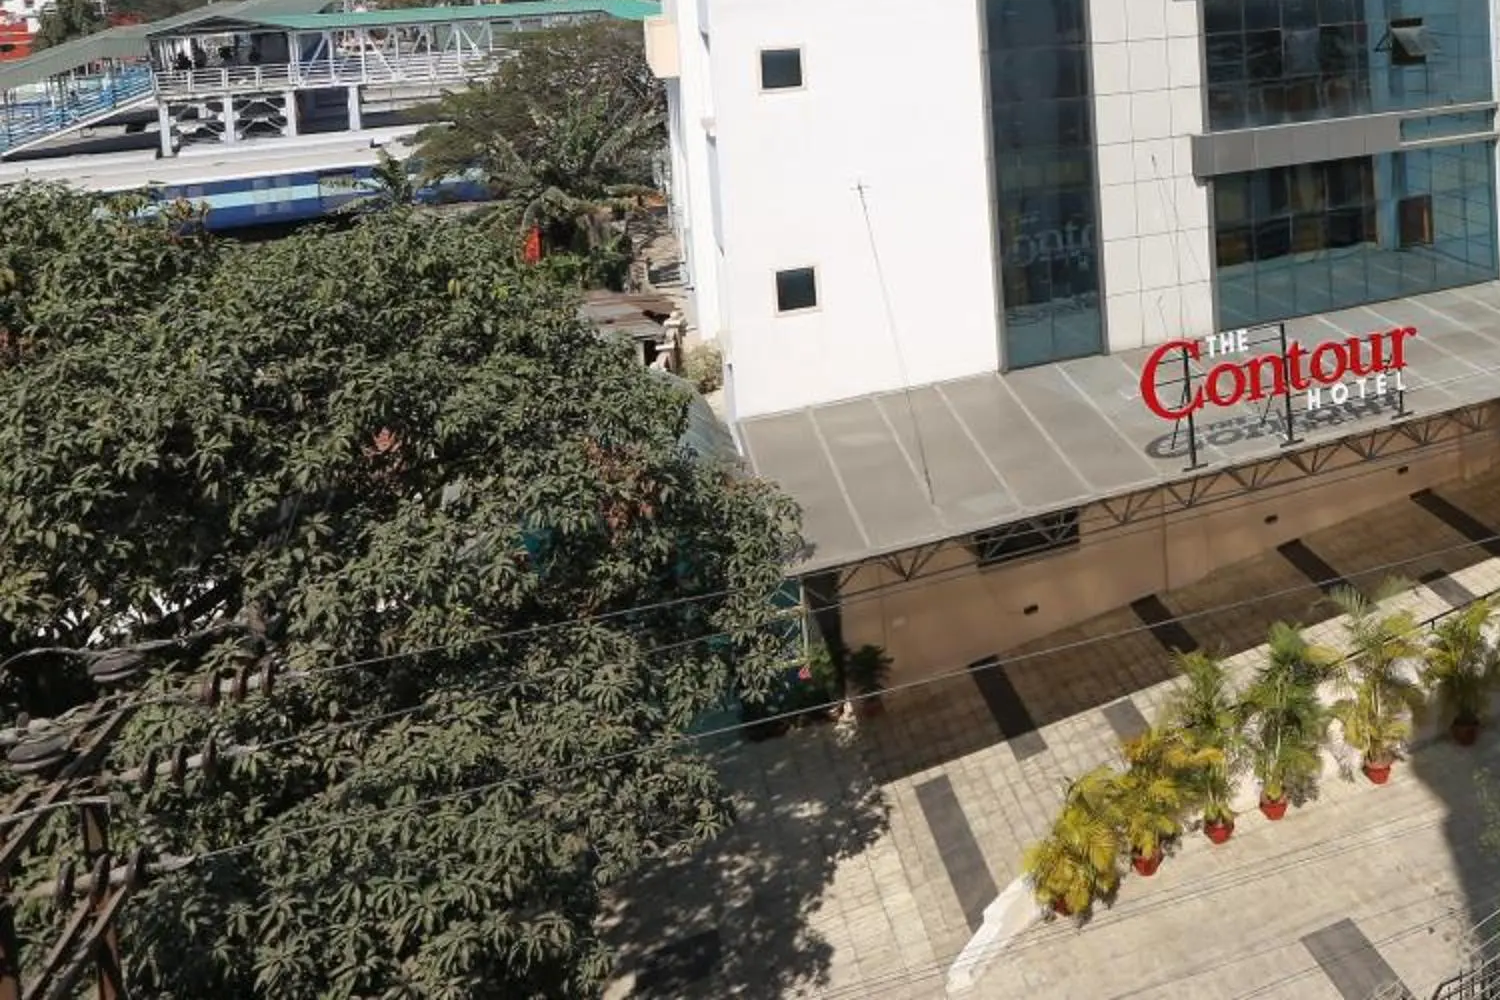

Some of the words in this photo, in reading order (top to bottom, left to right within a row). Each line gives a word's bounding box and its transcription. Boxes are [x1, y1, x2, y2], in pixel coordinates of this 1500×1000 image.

[1205, 329, 1249, 359] THE
[1140, 326, 1417, 420] Contour
[1307, 372, 1407, 410] HOTEL
